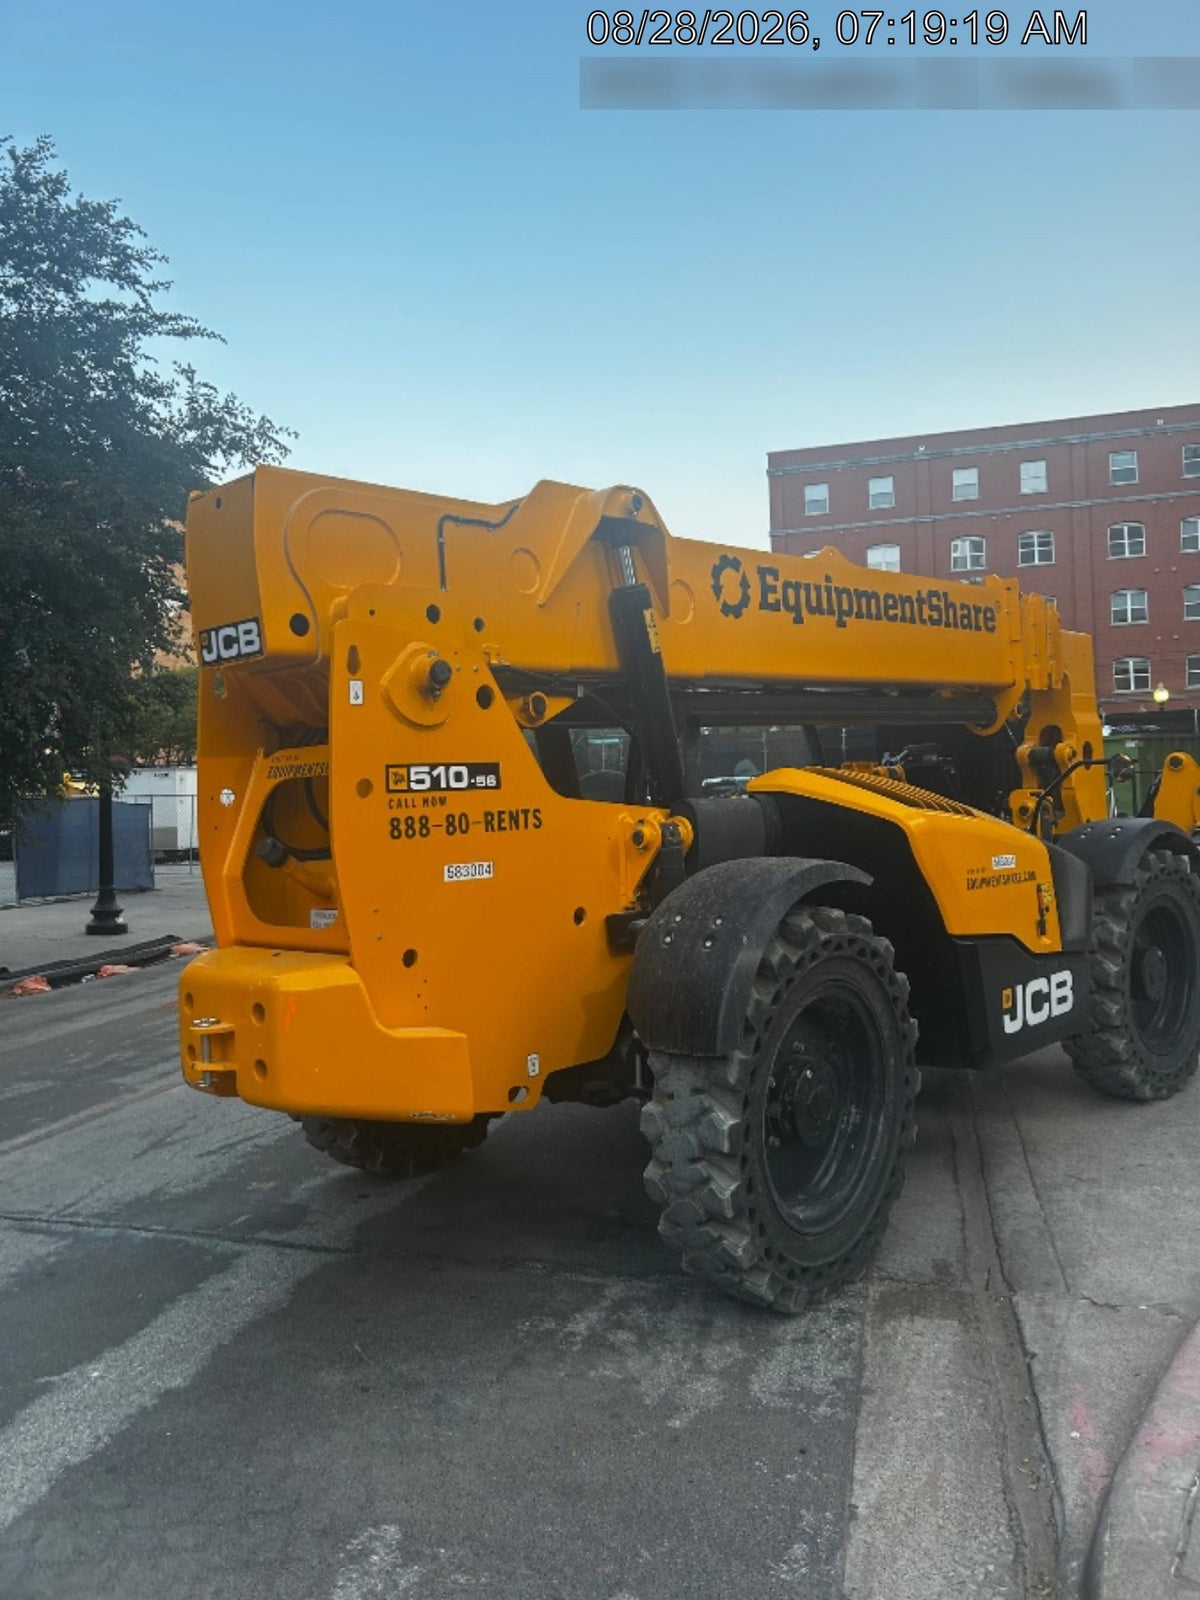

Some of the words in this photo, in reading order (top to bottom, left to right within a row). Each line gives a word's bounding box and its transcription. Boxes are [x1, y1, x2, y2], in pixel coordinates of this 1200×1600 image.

[757, 565, 996, 633] EquipmentShare
[202, 621, 260, 662] JCB
[388, 797, 417, 809] CALL
[422, 796, 447, 808] NOW
[389, 808, 543, 840] 888-80-RENTS
[446, 863, 492, 879] 583004
[1003, 970, 1074, 1034] JCB
